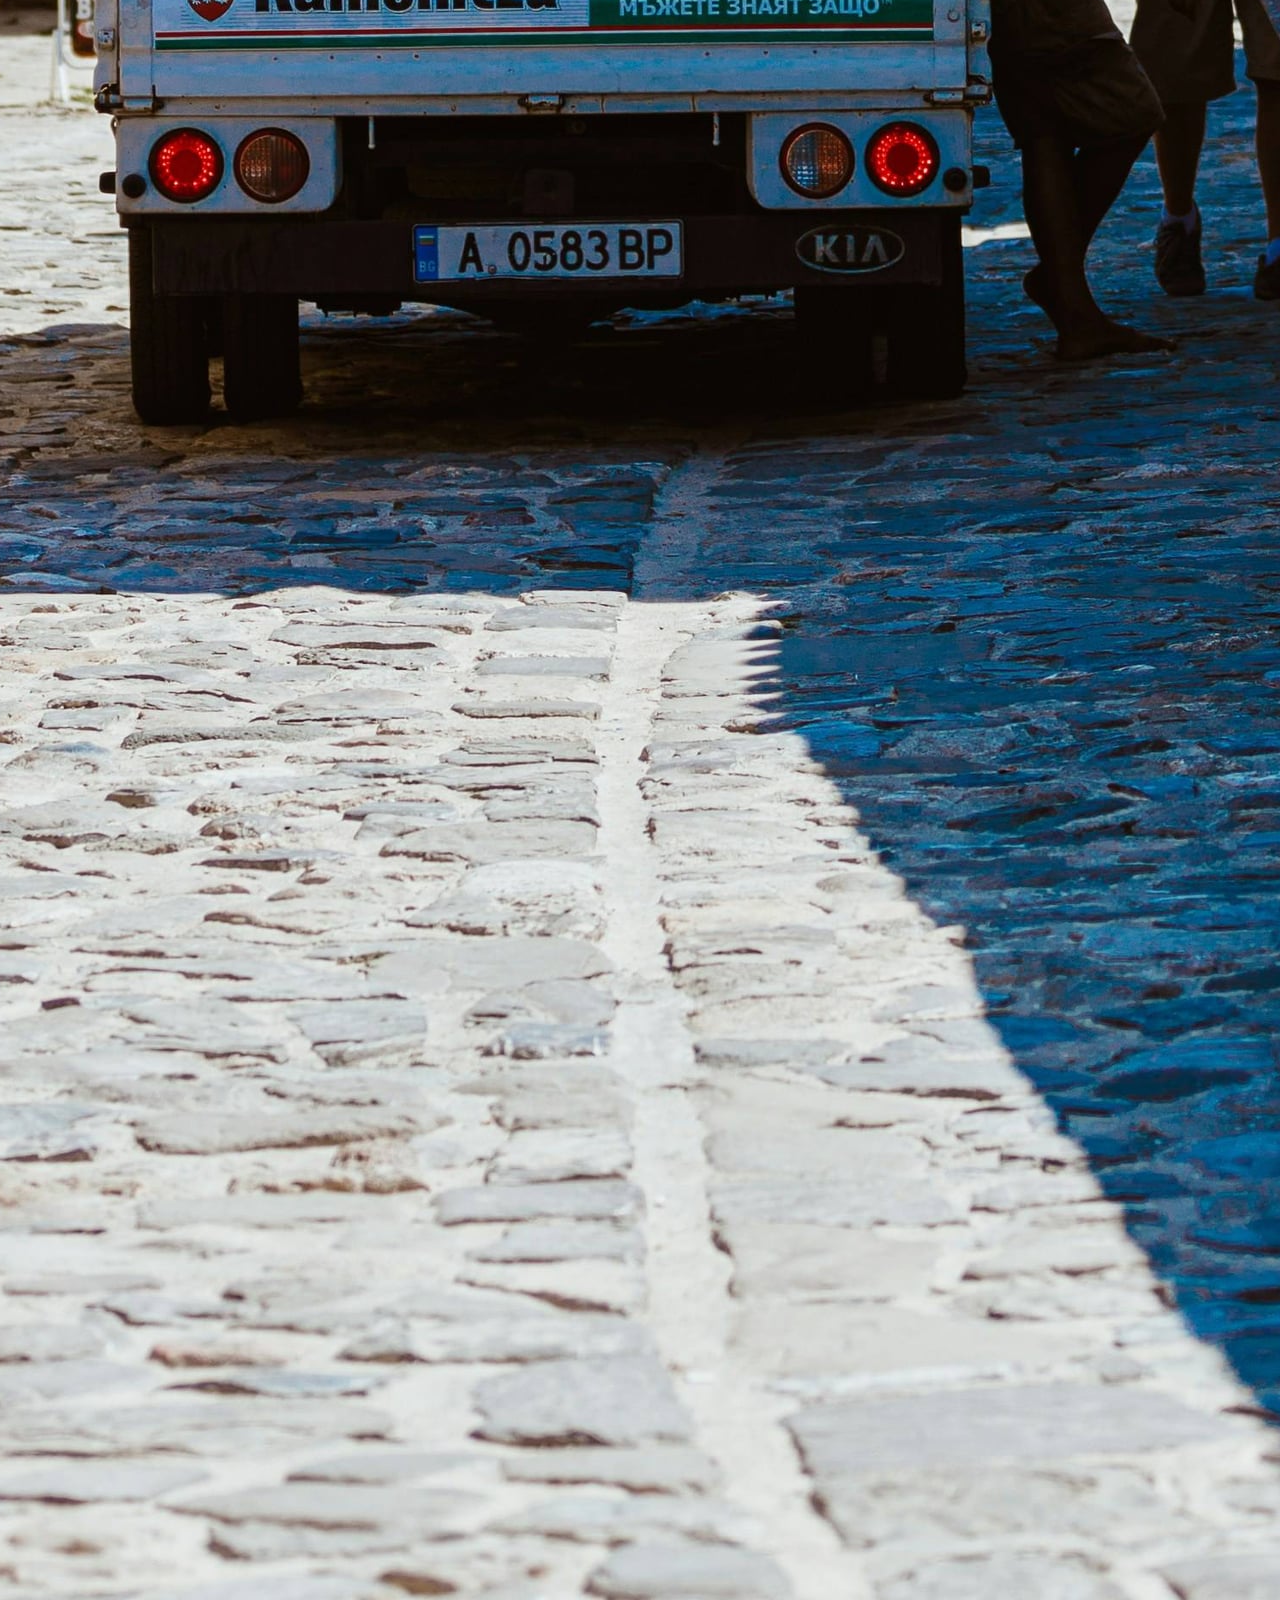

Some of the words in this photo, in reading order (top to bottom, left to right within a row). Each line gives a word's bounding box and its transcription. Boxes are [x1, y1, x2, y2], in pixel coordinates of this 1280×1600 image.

[457, 232, 485, 274] A
[507, 230, 610, 271] 0583
[618, 229, 674, 270] BP
[813, 233, 889, 263] KIA
[419, 260, 436, 274] BG
